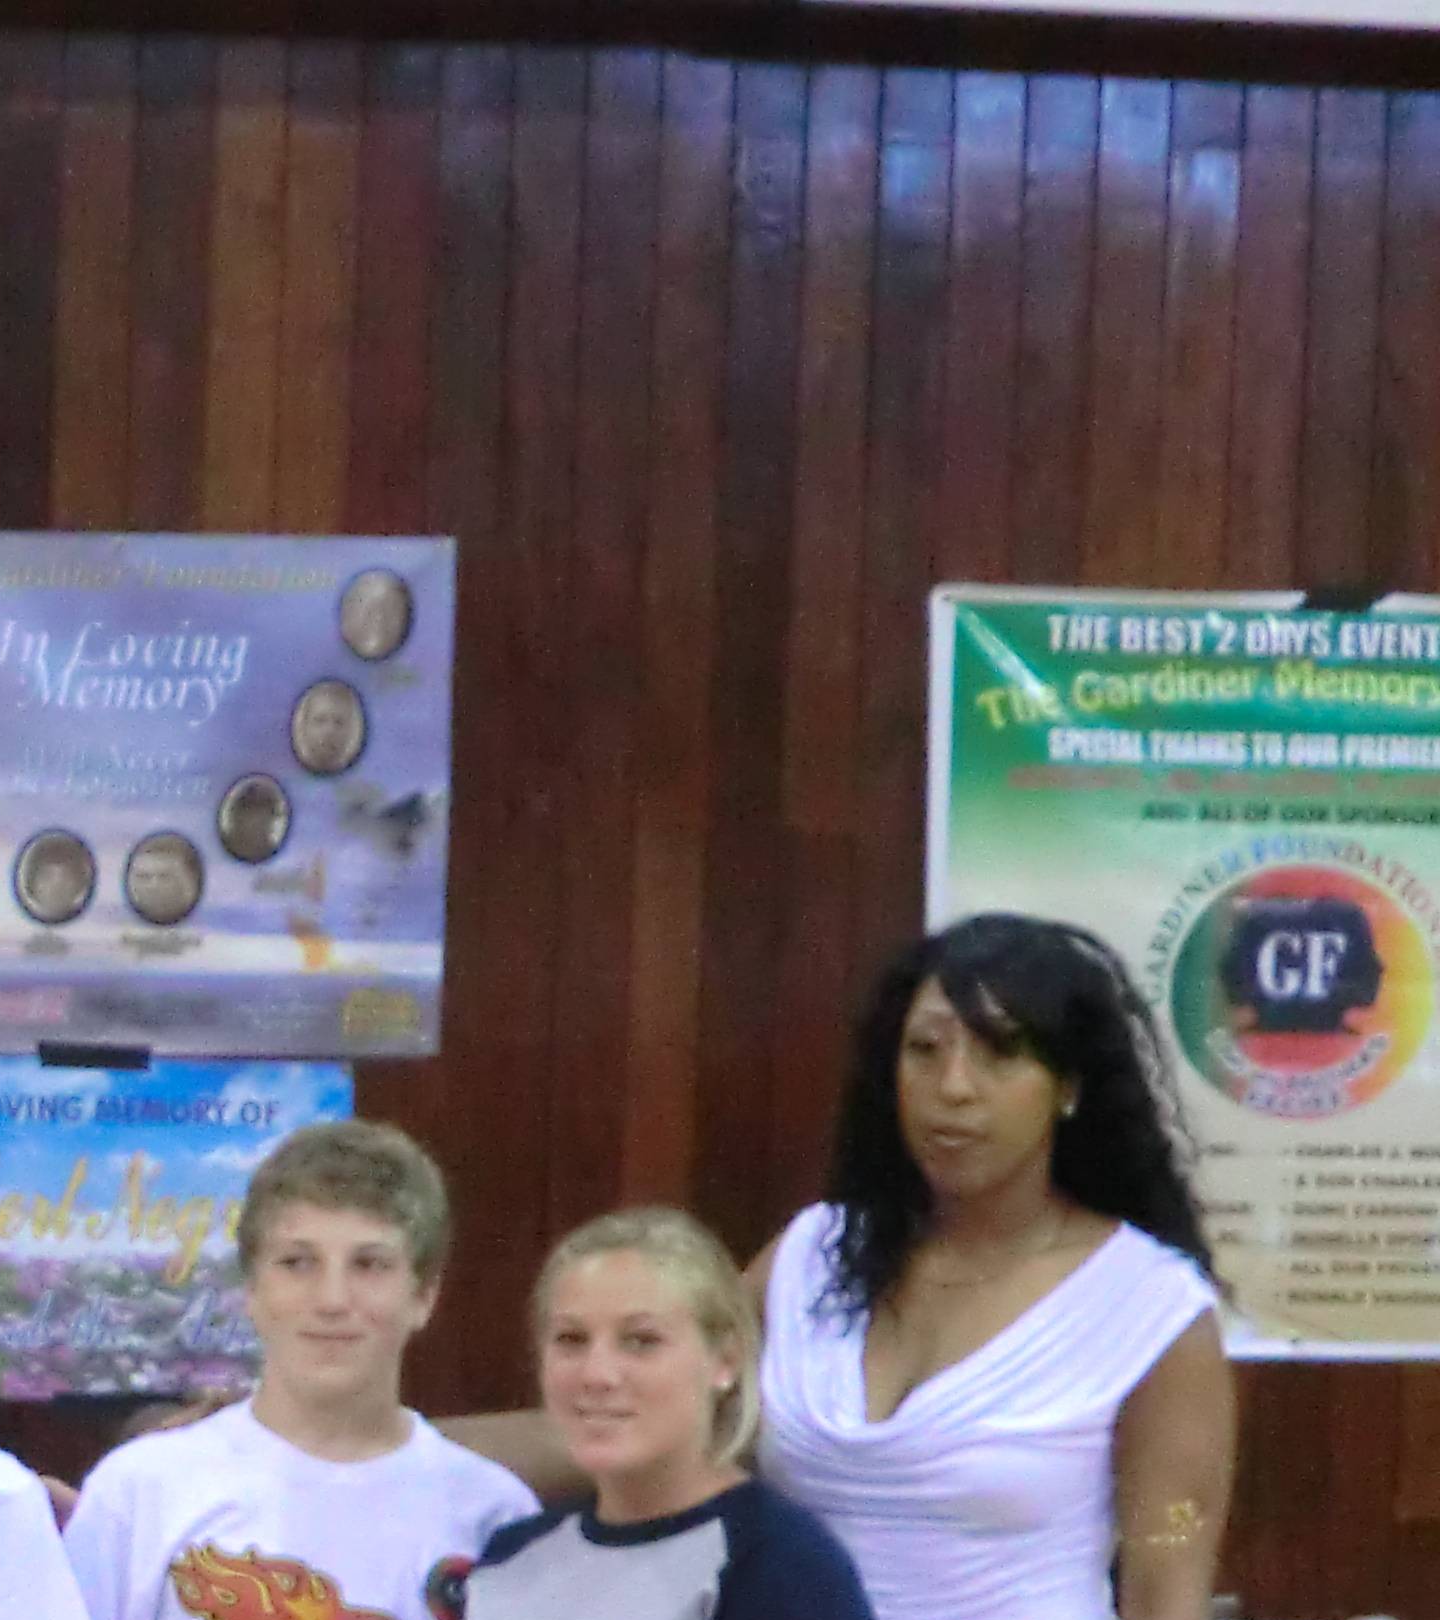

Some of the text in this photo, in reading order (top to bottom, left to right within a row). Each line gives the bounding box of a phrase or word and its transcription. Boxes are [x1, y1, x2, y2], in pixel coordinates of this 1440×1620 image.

[70, 620, 251, 684] Loving
[1048, 614, 1111, 653] THE
[1120, 616, 1205, 655] BEST
[1246, 617, 1332, 658] DAYS
[16, 660, 223, 727] Memory
[1073, 661, 1261, 713] Gardiner
[1251, 731, 1284, 766] TO
[94, 1098, 229, 1126] MEMORY
